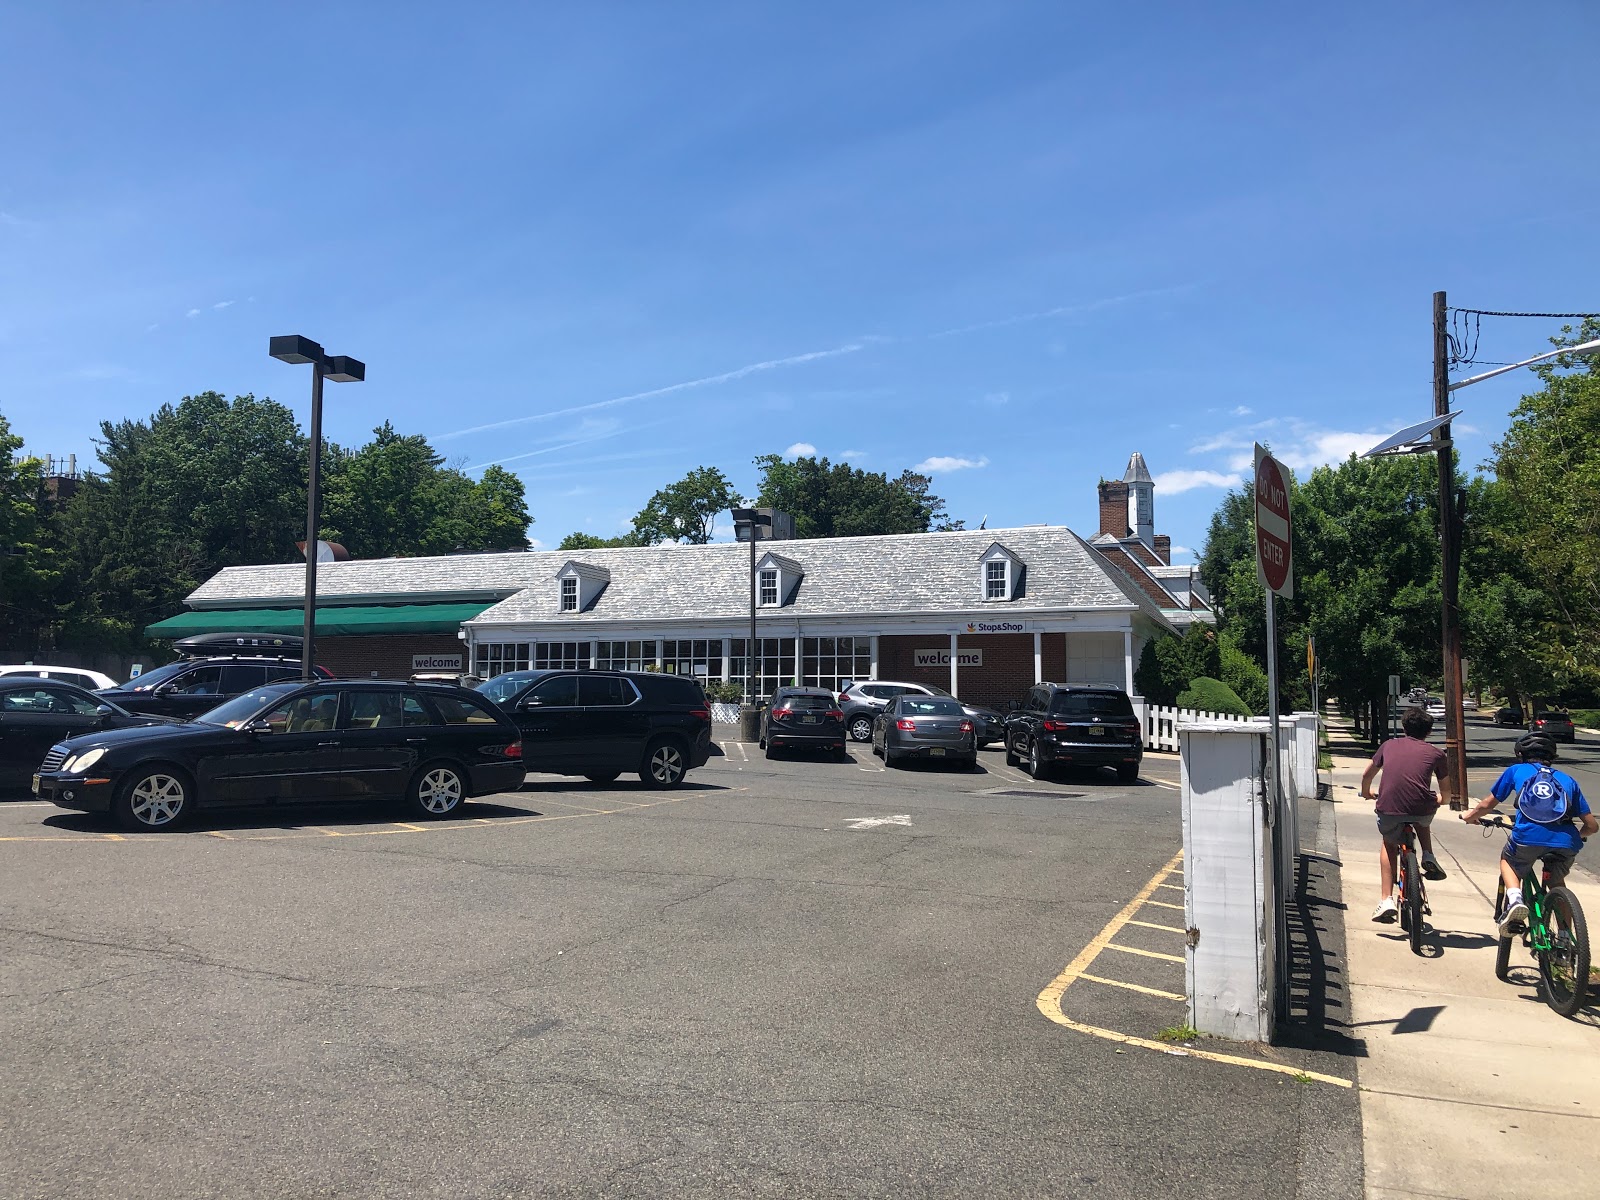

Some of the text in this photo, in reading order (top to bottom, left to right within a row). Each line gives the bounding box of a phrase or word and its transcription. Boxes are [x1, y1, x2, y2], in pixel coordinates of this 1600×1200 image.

[1259, 476, 1285, 511] DO NOT
[1263, 537, 1284, 567] ENTER
[978, 621, 1023, 632] Stop&Shop
[415, 656, 460, 667] welcome
[917, 651, 979, 664] welcme
[1536, 784, 1551, 796] R
